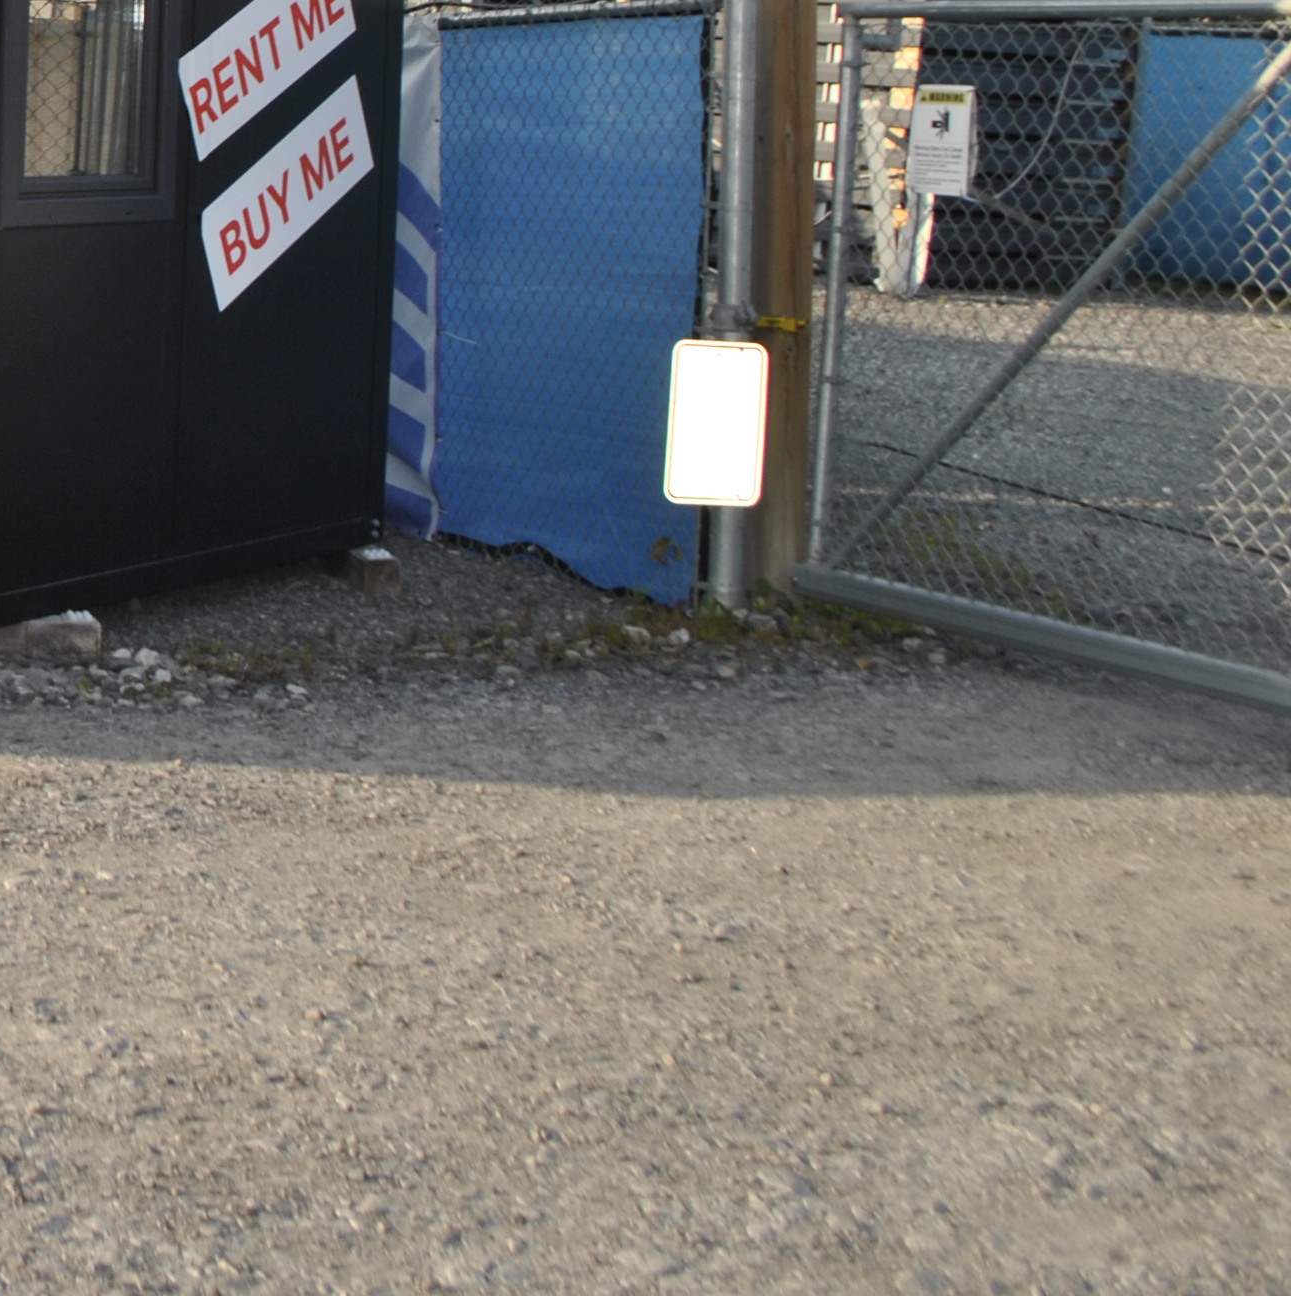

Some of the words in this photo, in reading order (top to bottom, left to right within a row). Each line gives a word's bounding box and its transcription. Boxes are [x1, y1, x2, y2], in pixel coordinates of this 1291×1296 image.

[188, 15, 281, 134] RENT
[219, 168, 290, 276] BUY
[299, 117, 354, 201] ME
